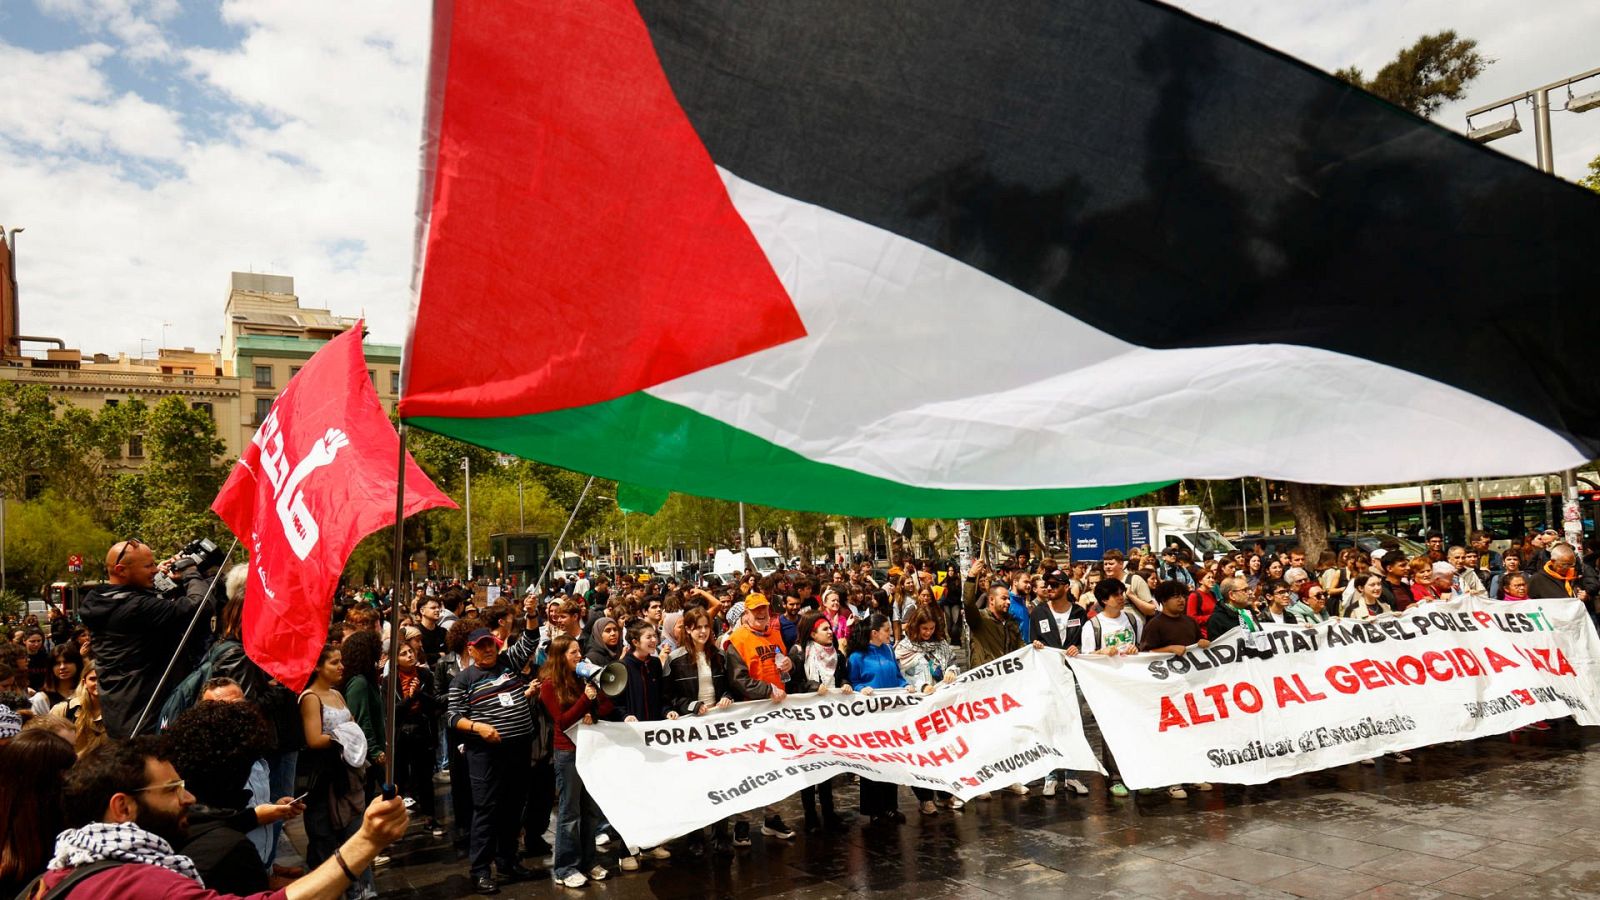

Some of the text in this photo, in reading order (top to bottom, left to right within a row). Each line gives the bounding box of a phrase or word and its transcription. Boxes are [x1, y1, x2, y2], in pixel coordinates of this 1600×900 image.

[1148, 628, 1319, 680] SOLIDAITAT
[1412, 611, 1479, 636] POBLE
[1472, 606, 1554, 633] PLESTÍ
[1158, 643, 1577, 733] ALTO AL GENOCIDI A AZA
[644, 726, 702, 747] FORA
[705, 721, 739, 741] LES
[740, 707, 816, 730] FORCES
[686, 737, 775, 762] ABAIX
[774, 733, 803, 751] EL
[807, 725, 914, 750] GOVERN
[914, 691, 1024, 742] FEIXISTA
[1206, 714, 1417, 769] Sindicat d'Estudiants
[706, 771, 783, 806] Sindicat
